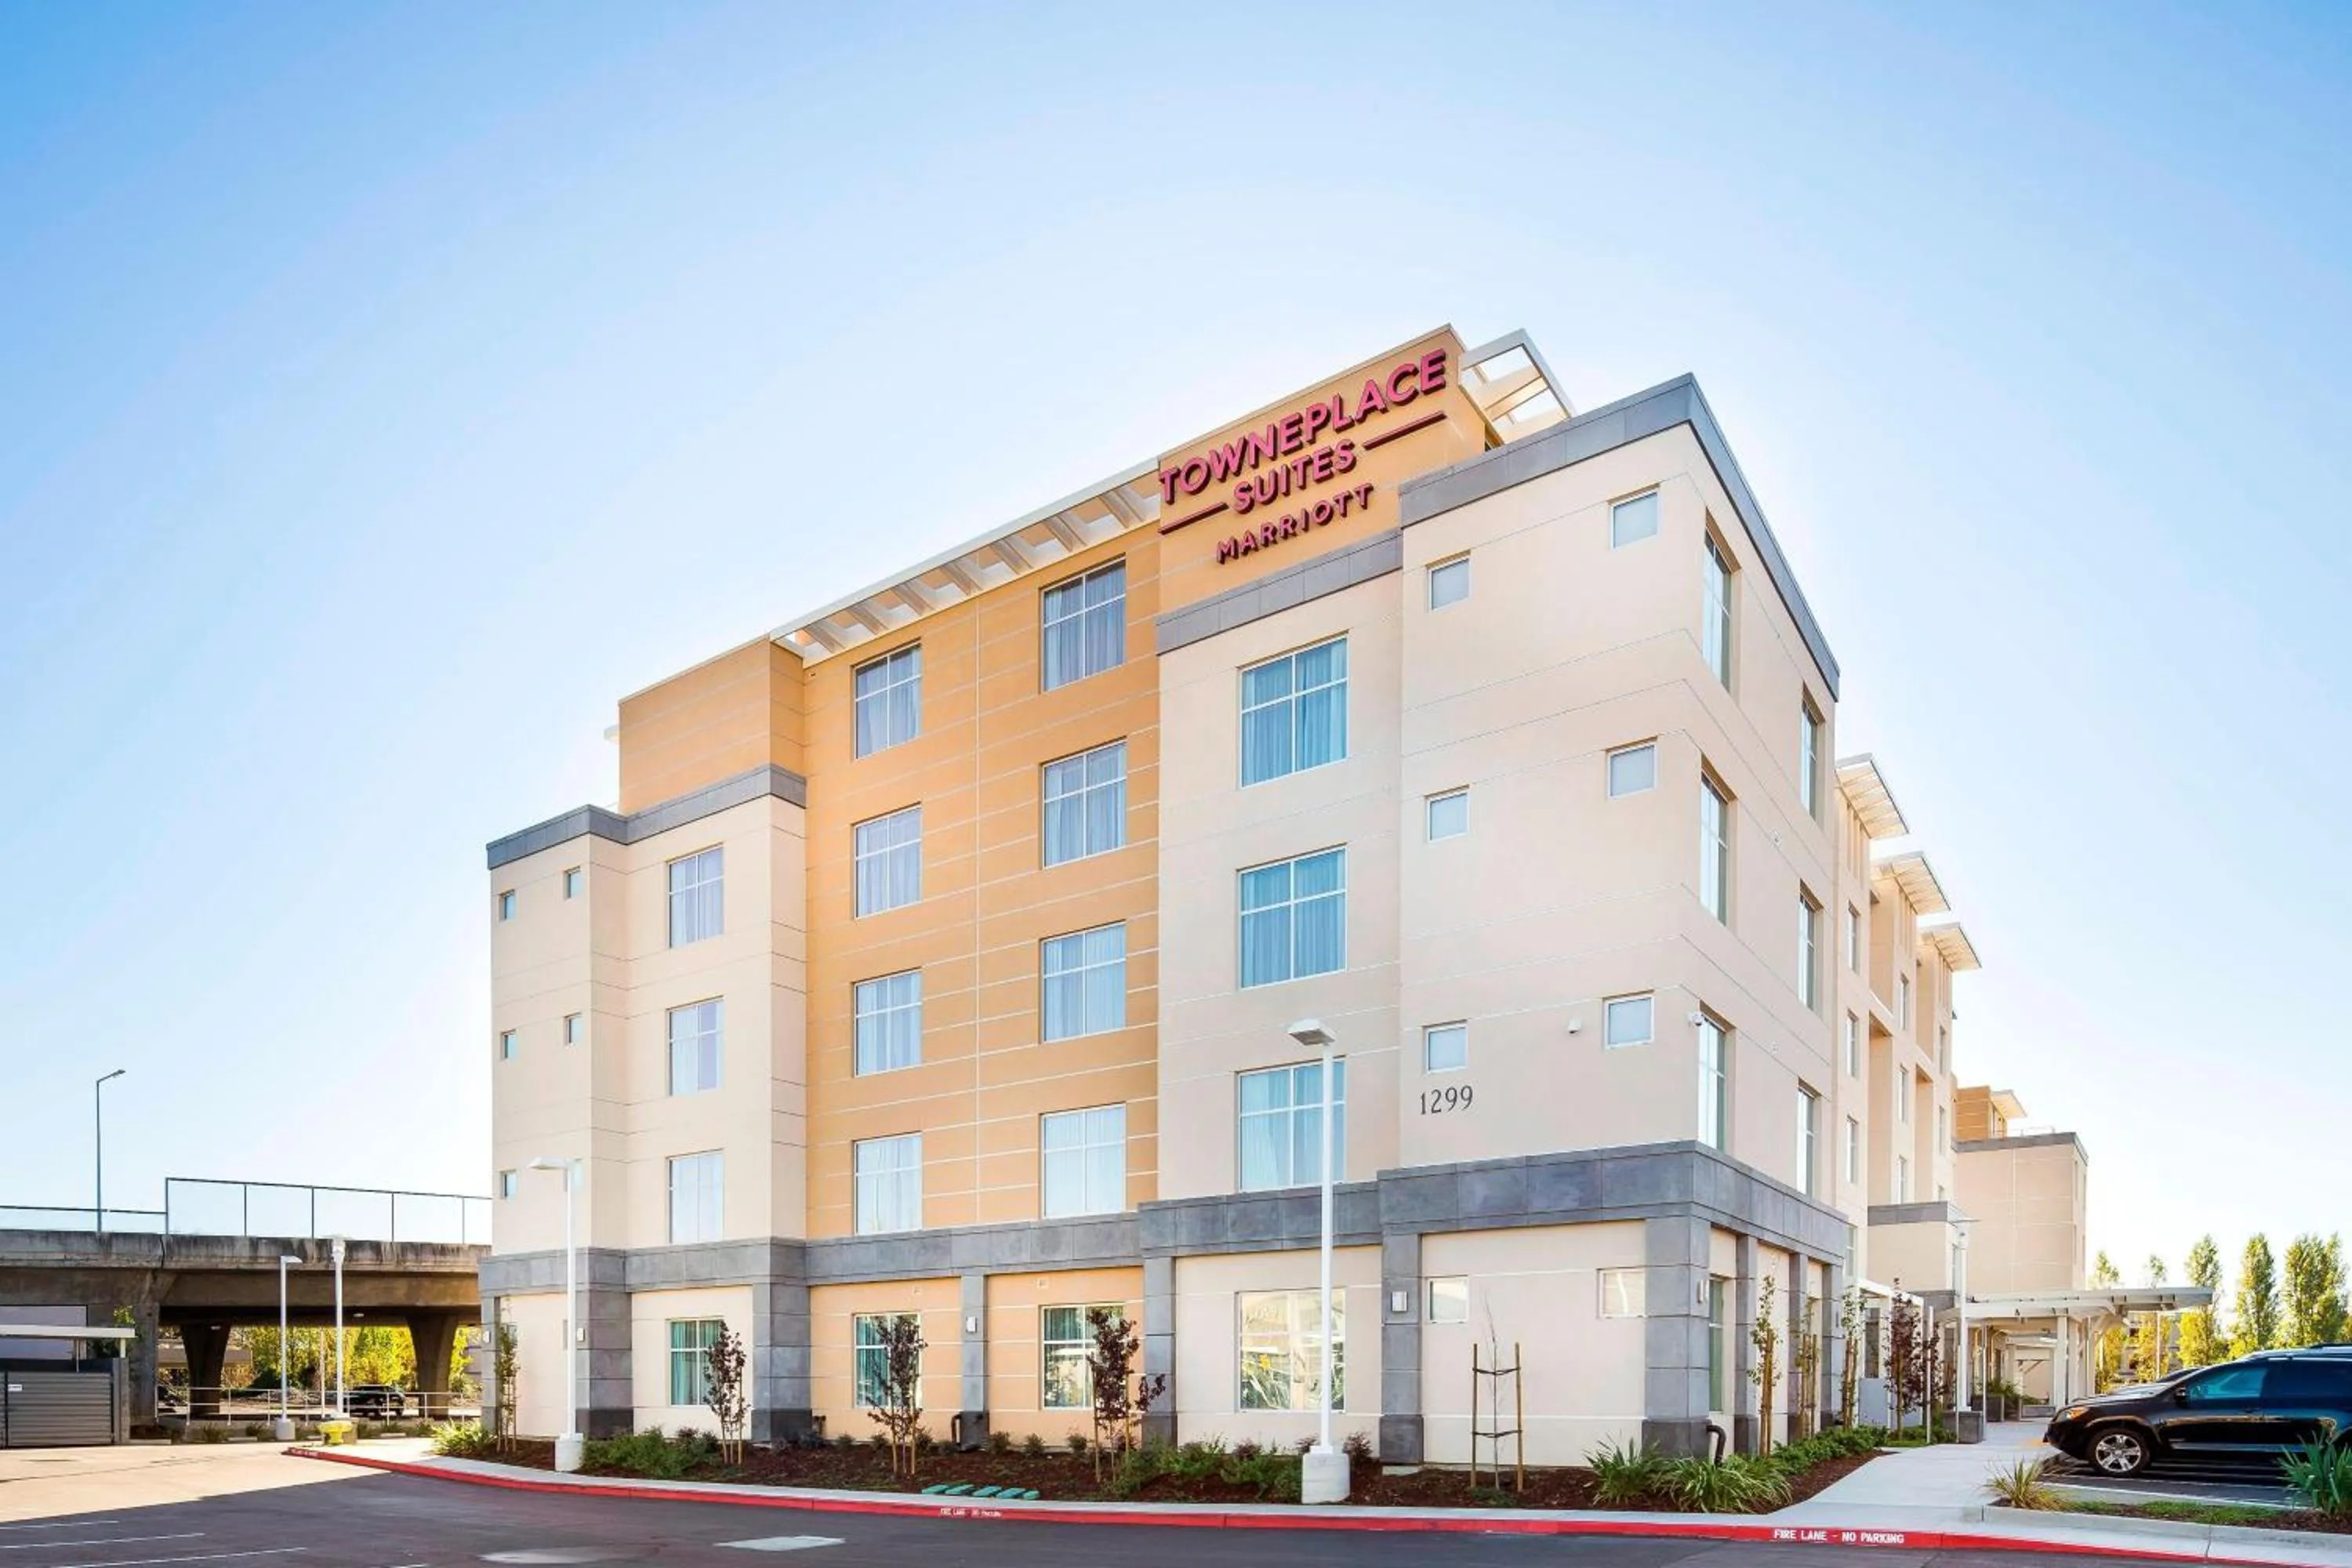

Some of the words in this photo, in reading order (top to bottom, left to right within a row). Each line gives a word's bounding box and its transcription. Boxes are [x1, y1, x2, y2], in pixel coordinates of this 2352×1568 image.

[1159, 348, 1446, 504] TOWNEPLACE
[1233, 439, 1356, 514] SUITES
[1216, 482, 1374, 564] MARRIOTT
[1421, 1085, 1472, 1115] 1299
[1774, 1530, 1796, 1539] FIRE
[1801, 1530, 1828, 1541] LANE
[1842, 1532, 1857, 1542] NO
[1860, 1533, 1904, 1544] PARKING
